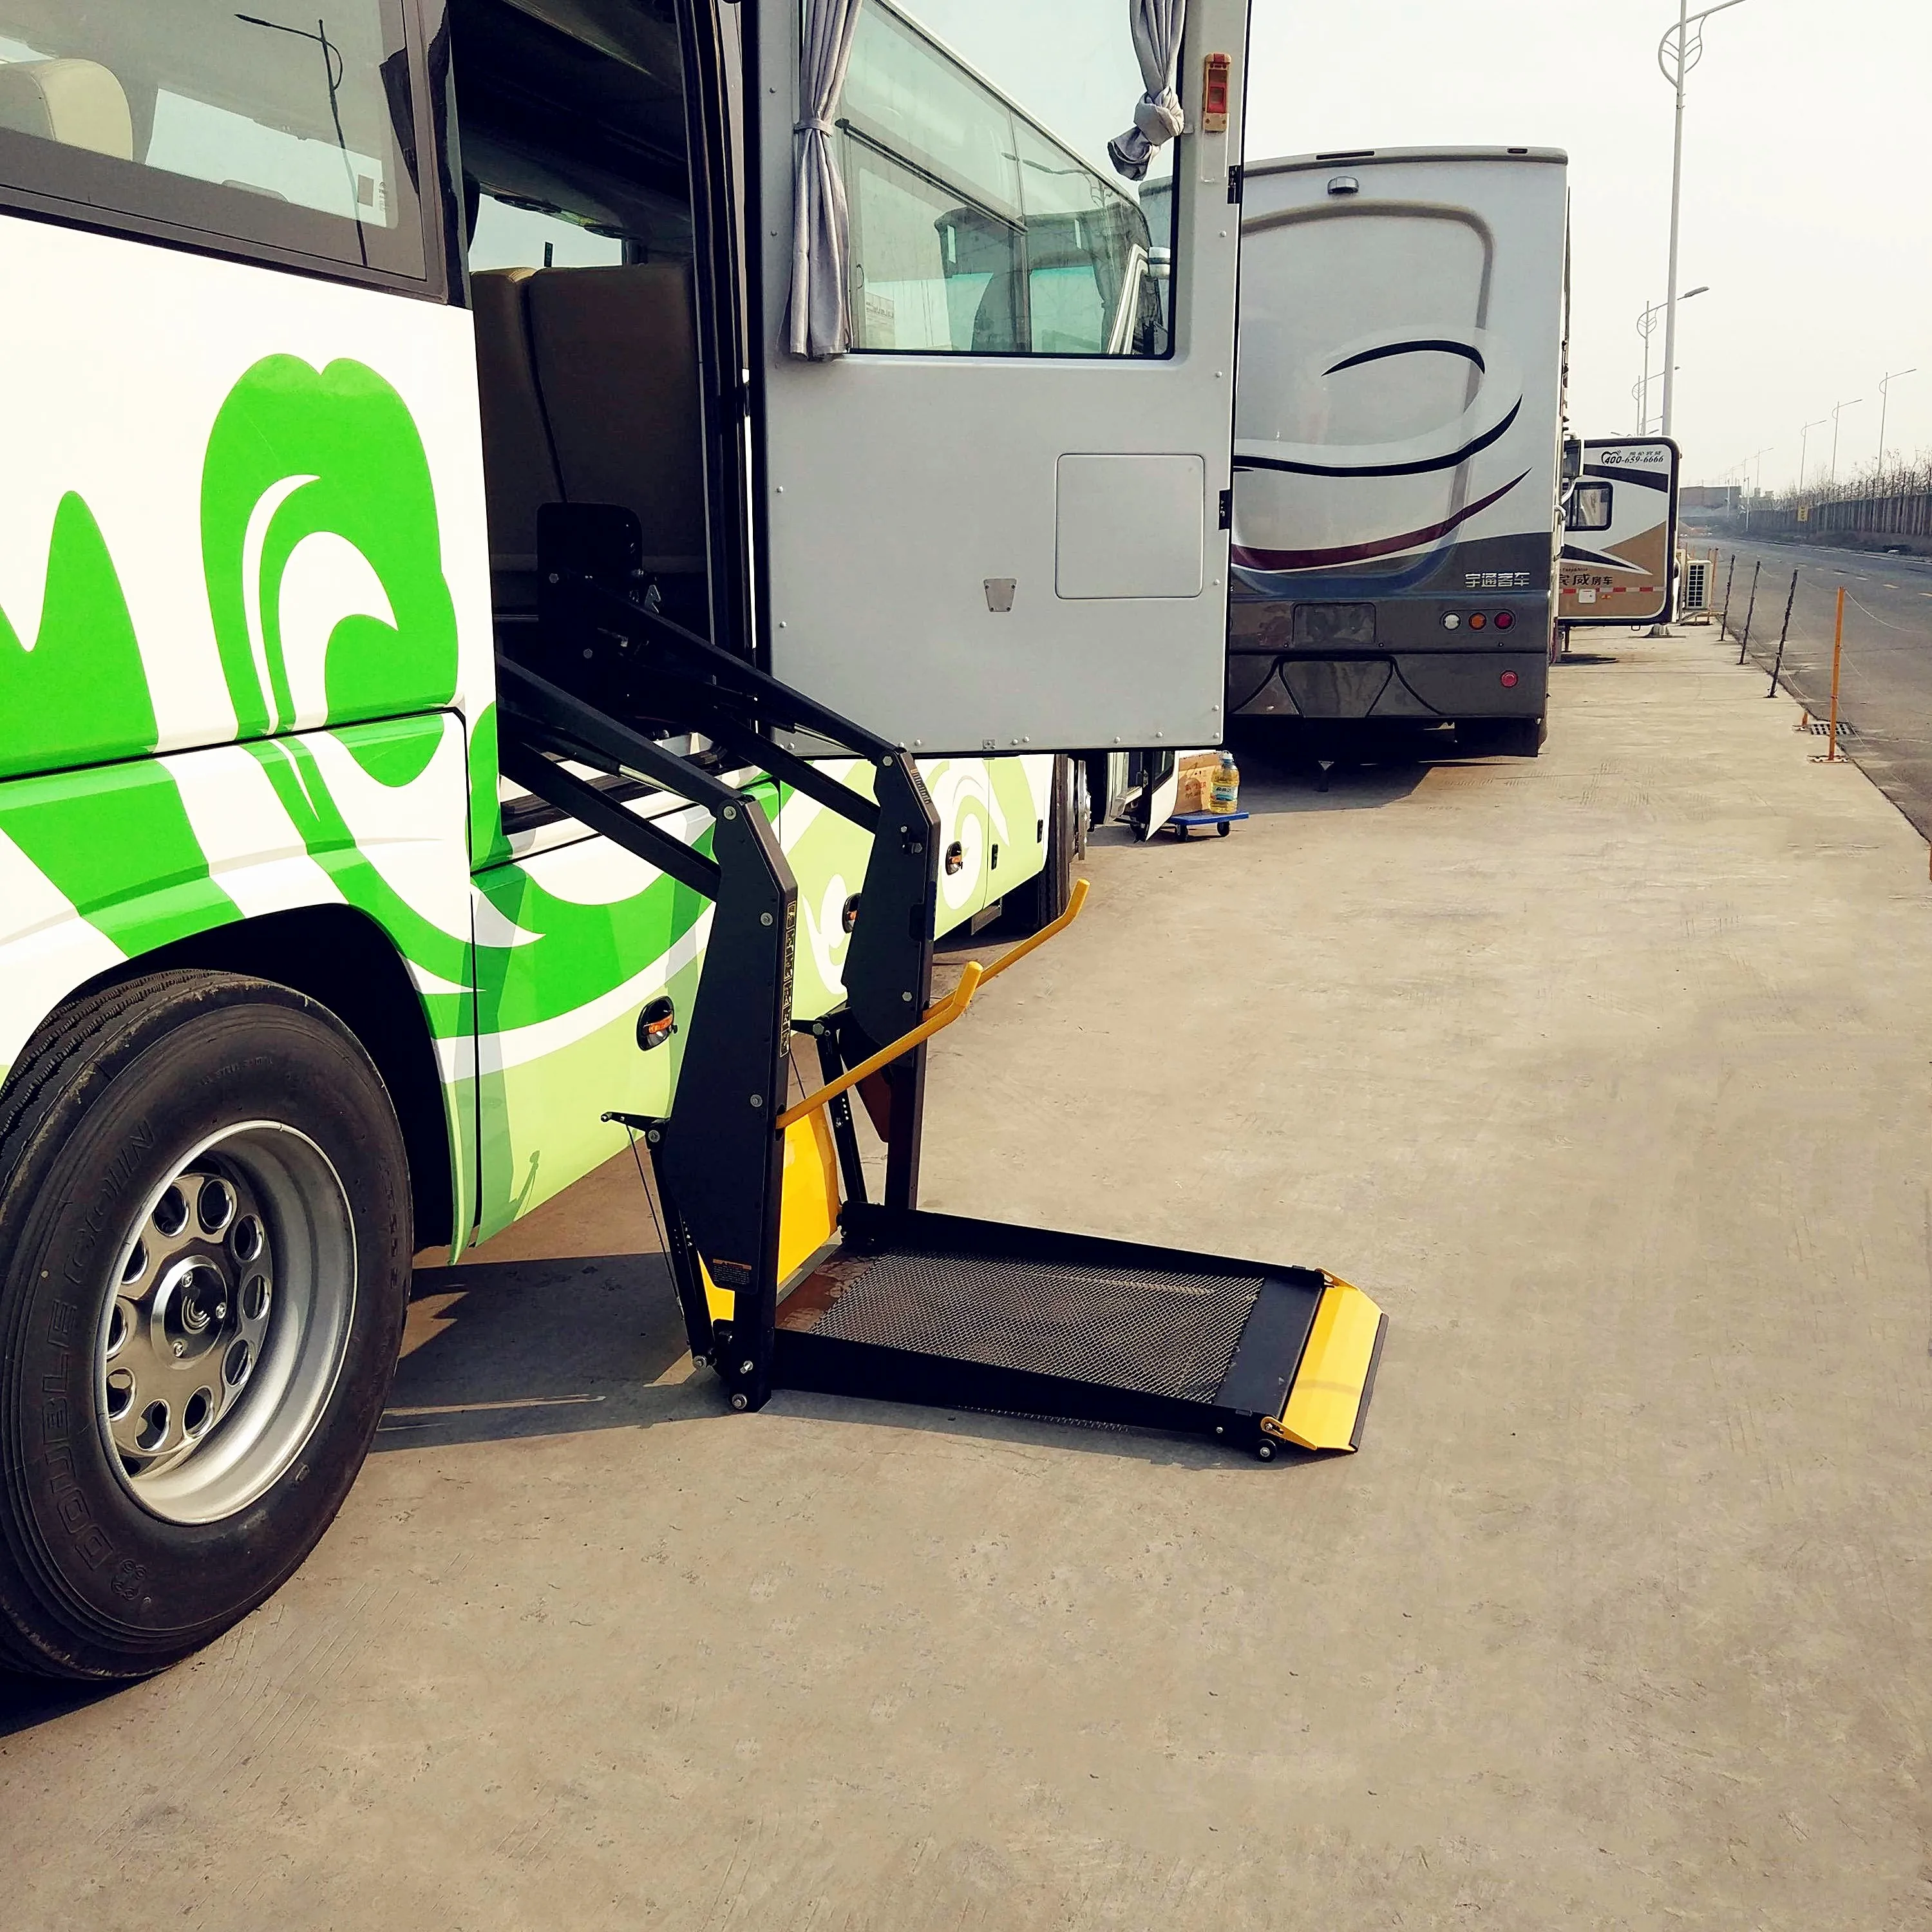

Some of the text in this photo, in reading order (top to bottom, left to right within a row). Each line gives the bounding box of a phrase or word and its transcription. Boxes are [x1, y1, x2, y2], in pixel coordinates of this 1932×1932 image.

[1604, 455, 1664, 464] 400-659-6666
[1464, 572, 1531, 588] 宇通客车
[42, 1298, 113, 1571] DOUBLE
